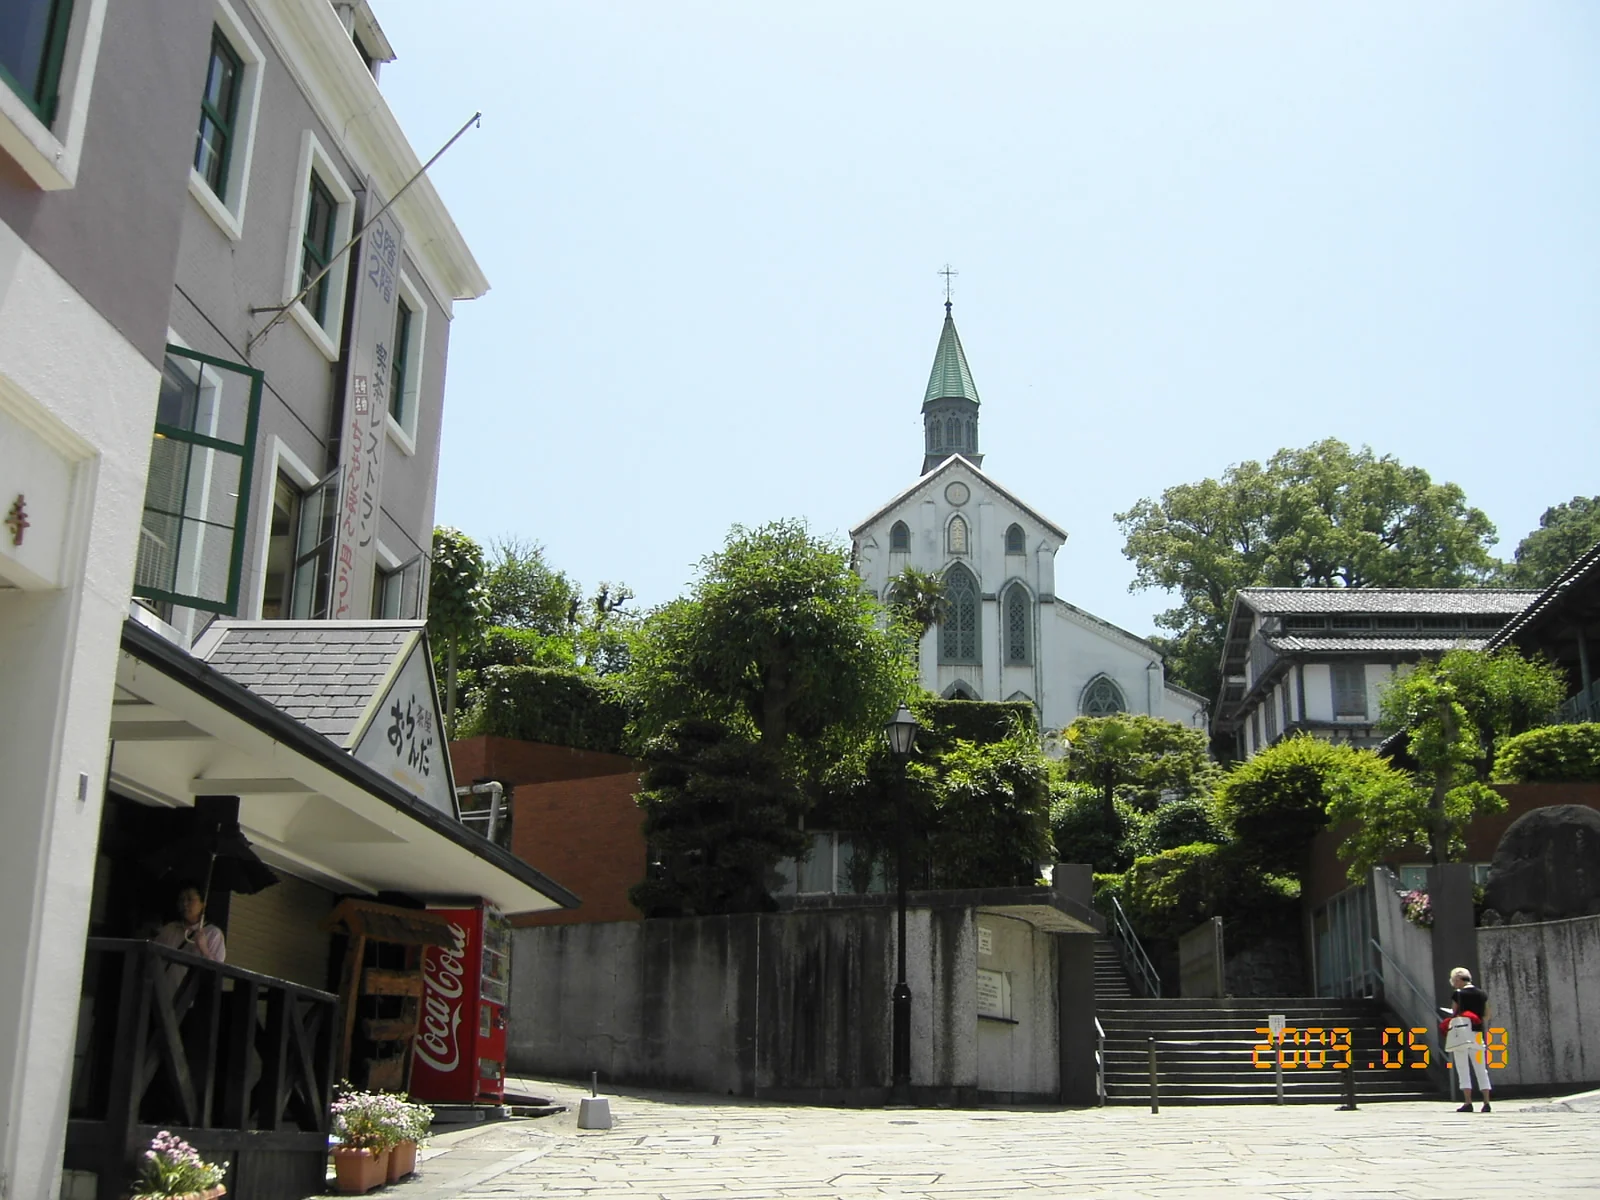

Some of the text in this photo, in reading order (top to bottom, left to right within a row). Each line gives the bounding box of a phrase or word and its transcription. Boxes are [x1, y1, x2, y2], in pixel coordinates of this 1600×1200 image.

[372, 217, 397, 269] 3階
[368, 254, 393, 304] 2階
[360, 341, 388, 548] 喫茶レストラン
[387, 693, 432, 777] おらんだ
